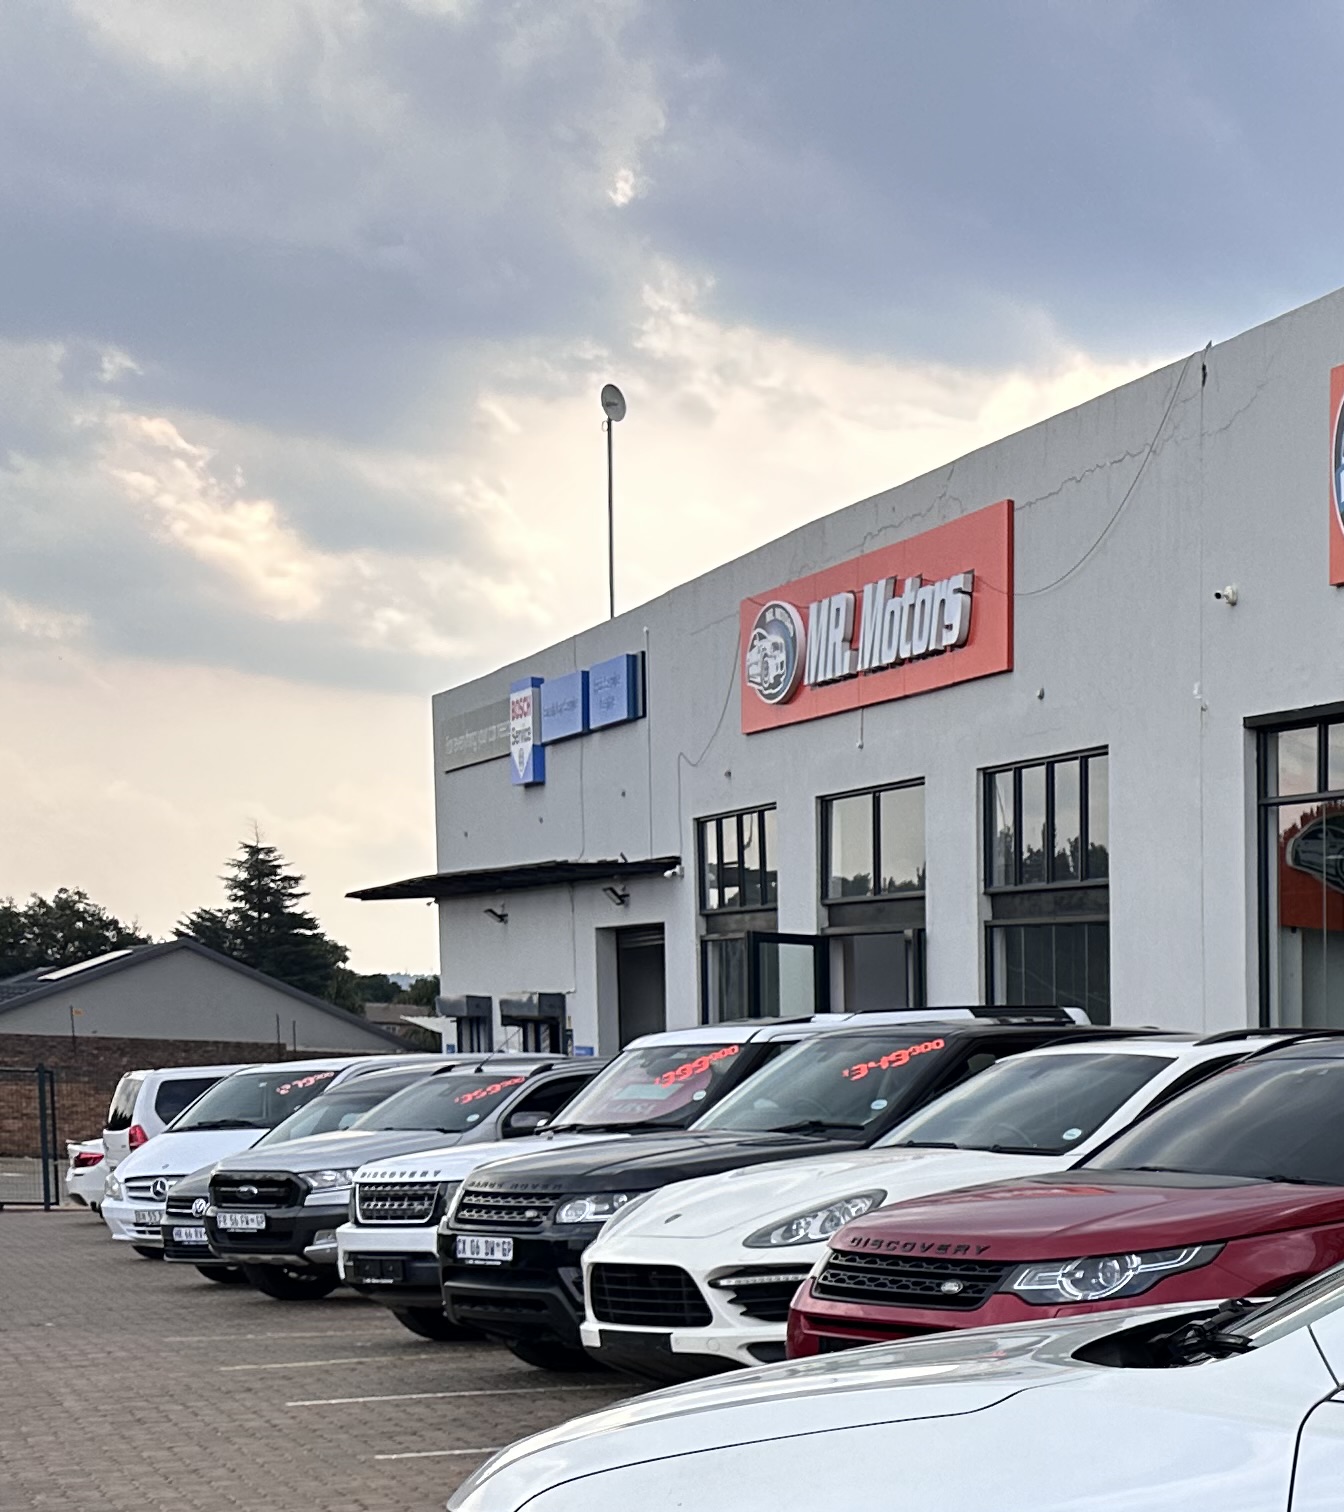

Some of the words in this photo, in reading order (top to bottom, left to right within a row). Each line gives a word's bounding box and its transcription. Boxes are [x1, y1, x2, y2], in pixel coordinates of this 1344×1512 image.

[804, 592, 858, 686] MR.
[857, 573, 973, 672] Motors
[360, 1169, 442, 1179] DISCOVERY
[850, 1236, 991, 1256] DISCOVERY
